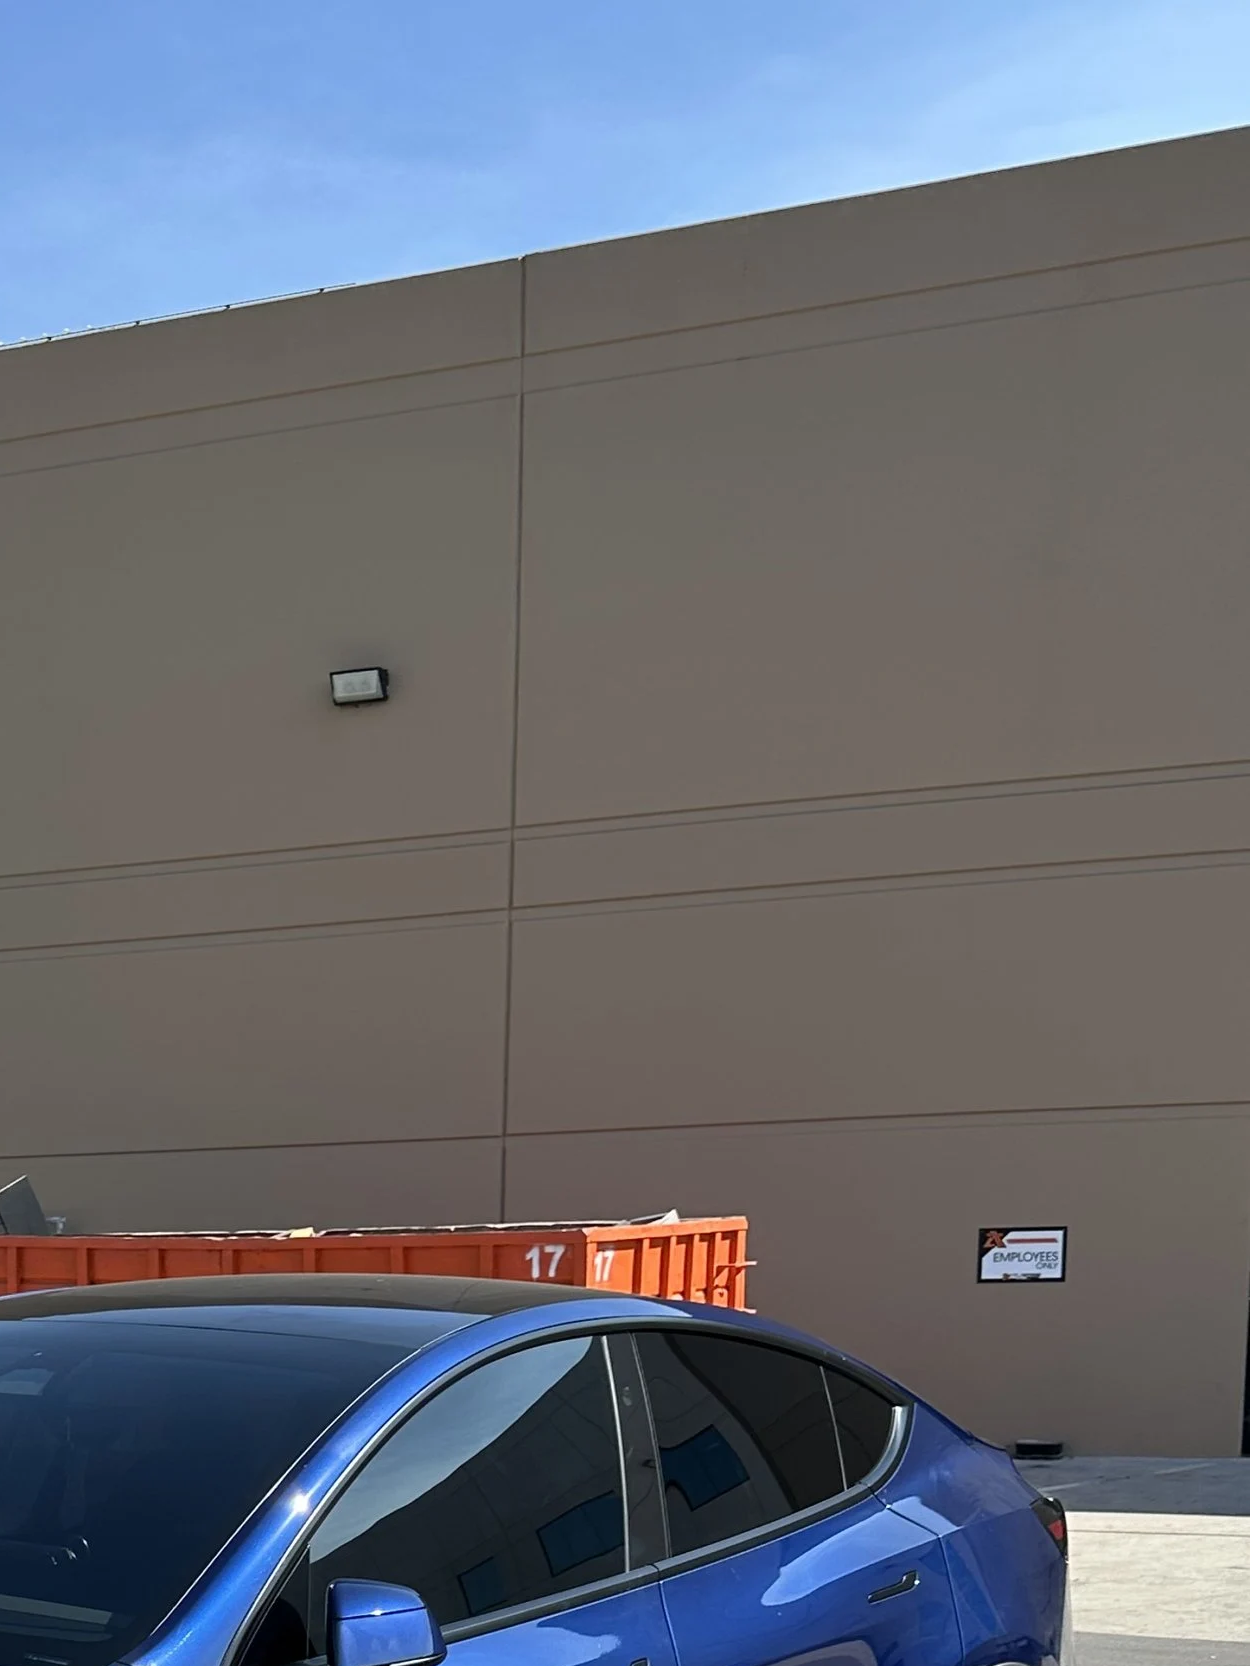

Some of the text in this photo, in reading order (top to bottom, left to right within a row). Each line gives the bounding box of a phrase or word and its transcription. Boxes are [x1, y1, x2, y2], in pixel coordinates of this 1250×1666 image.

[524, 1244, 566, 1281] 17
[593, 1249, 616, 1283] 17
[992, 1251, 1059, 1263] EMPLOYEES
[1035, 1262, 1059, 1270] ONLY
